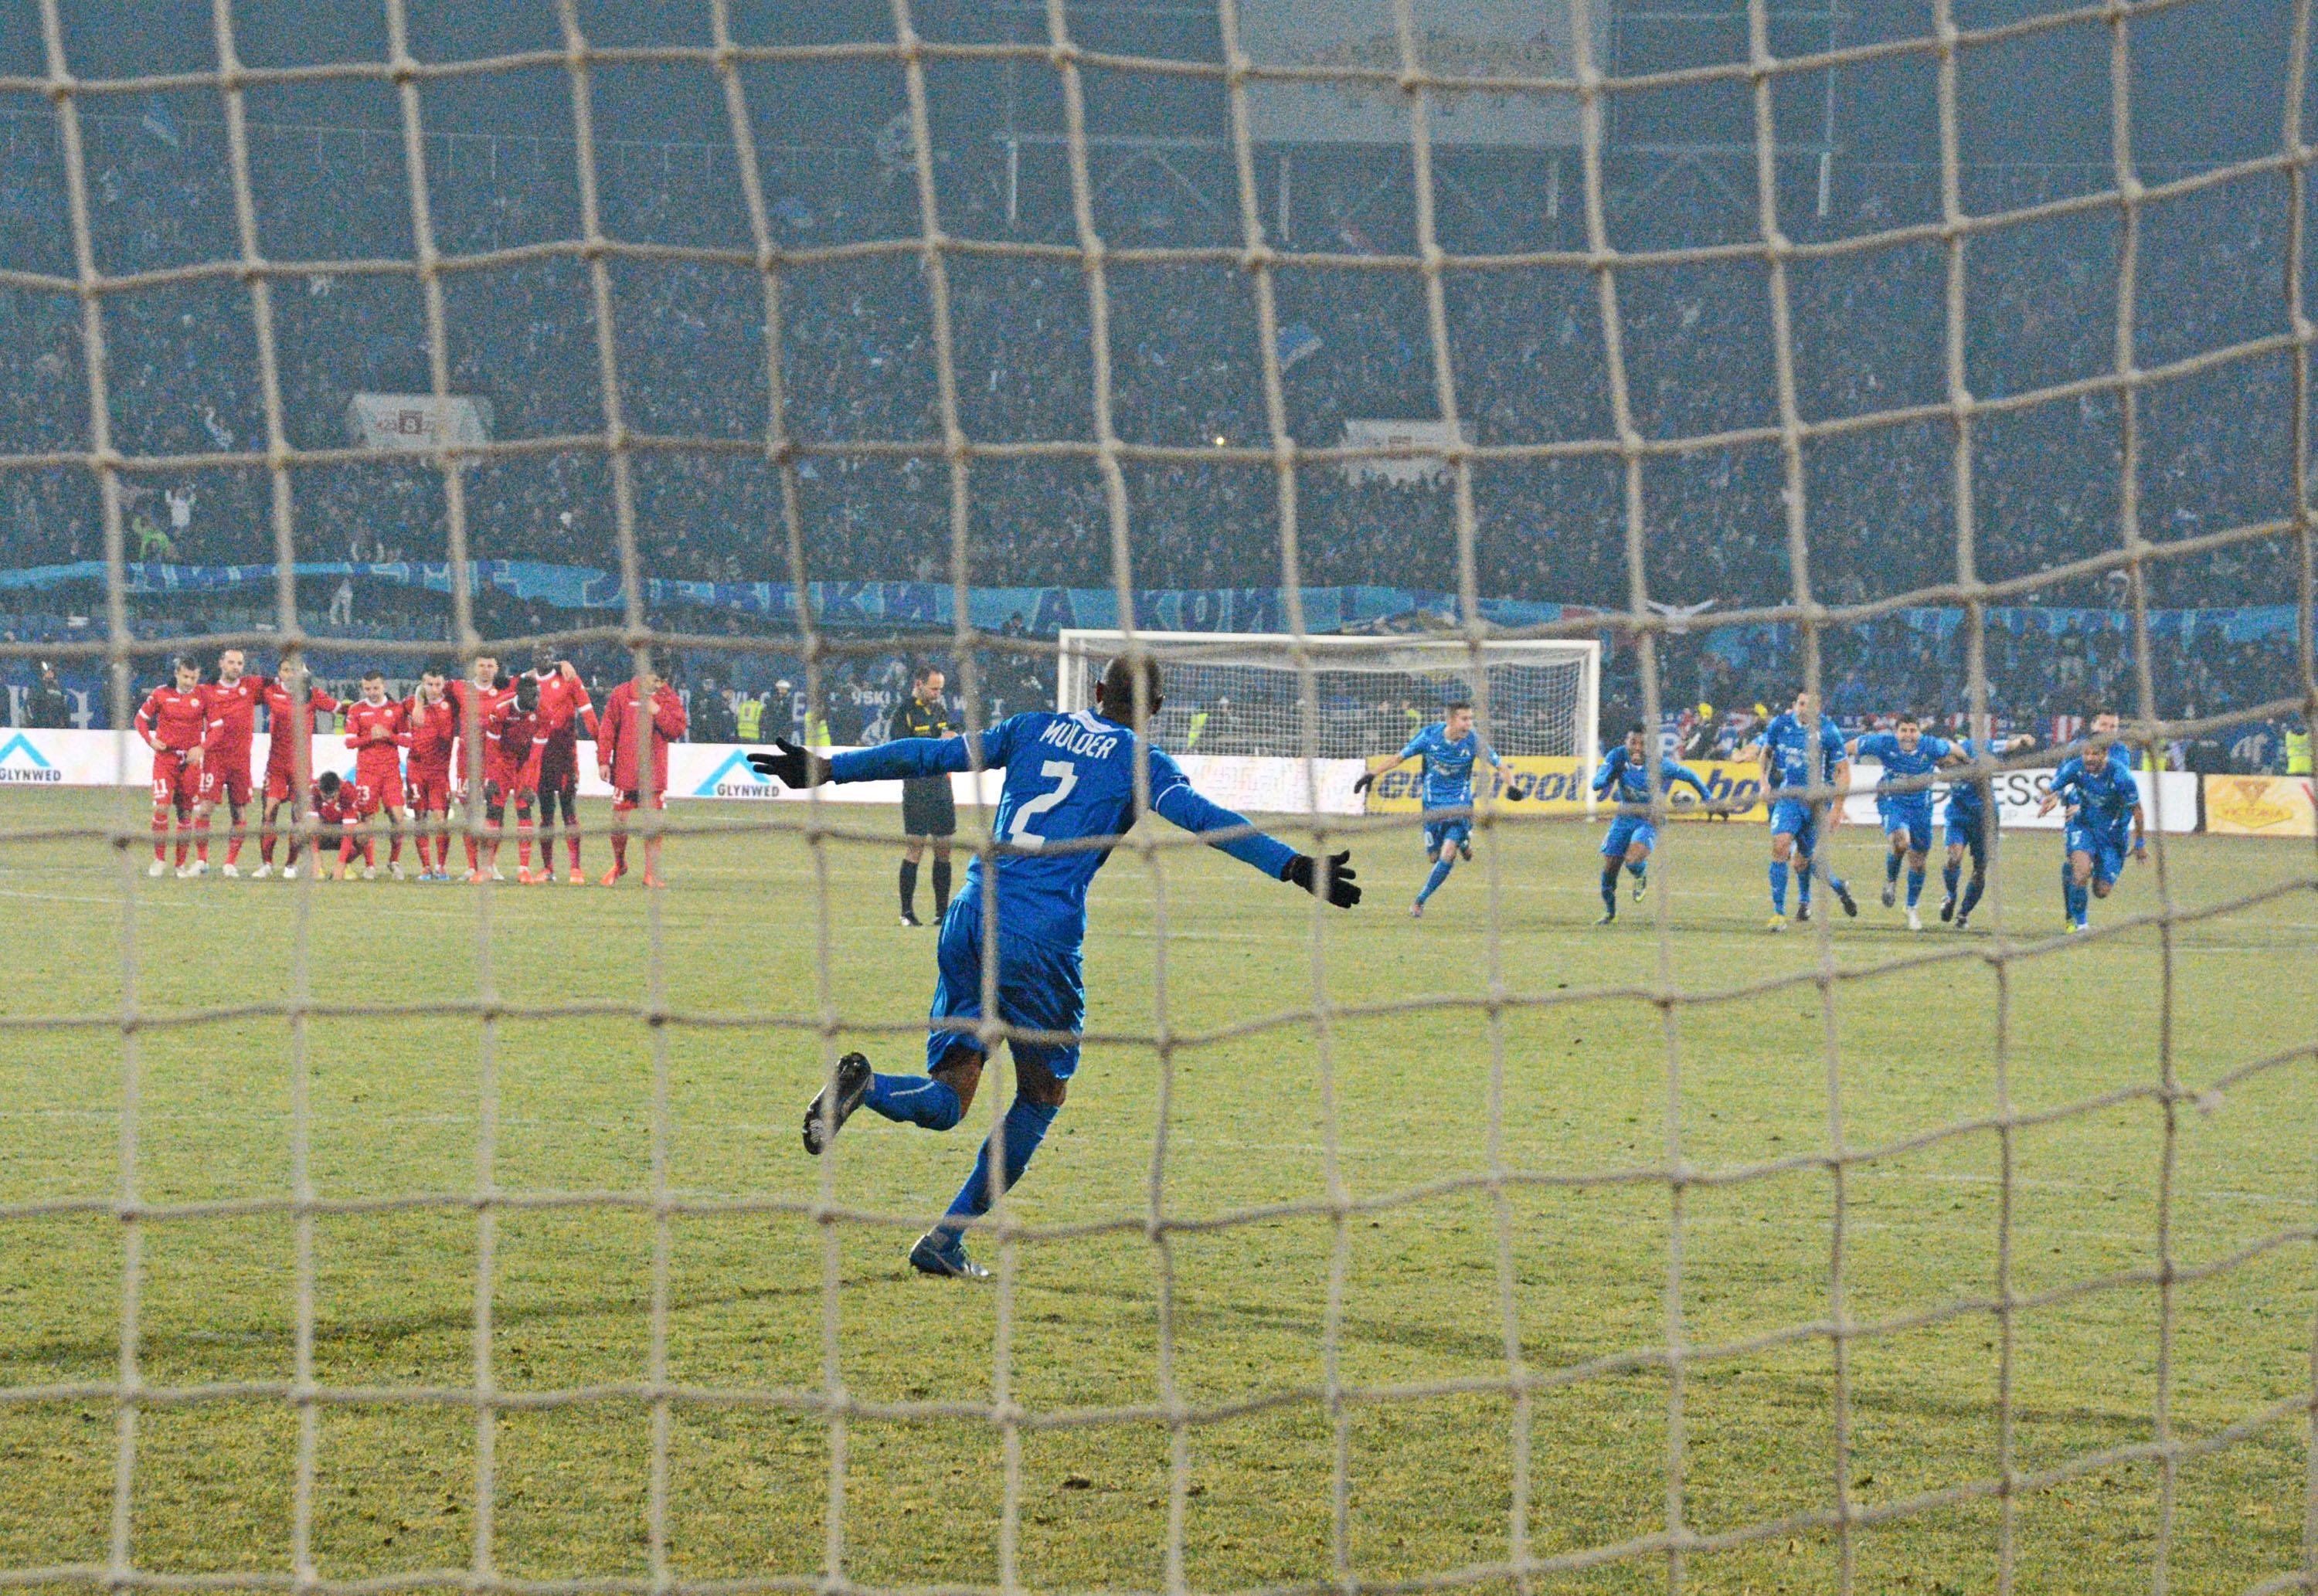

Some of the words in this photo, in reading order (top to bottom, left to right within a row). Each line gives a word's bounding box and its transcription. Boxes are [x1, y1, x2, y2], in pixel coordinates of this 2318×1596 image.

[1039, 719, 1117, 759] MULDER
[716, 783, 780, 797] GLYNWED
[1008, 759, 1079, 847] 2
